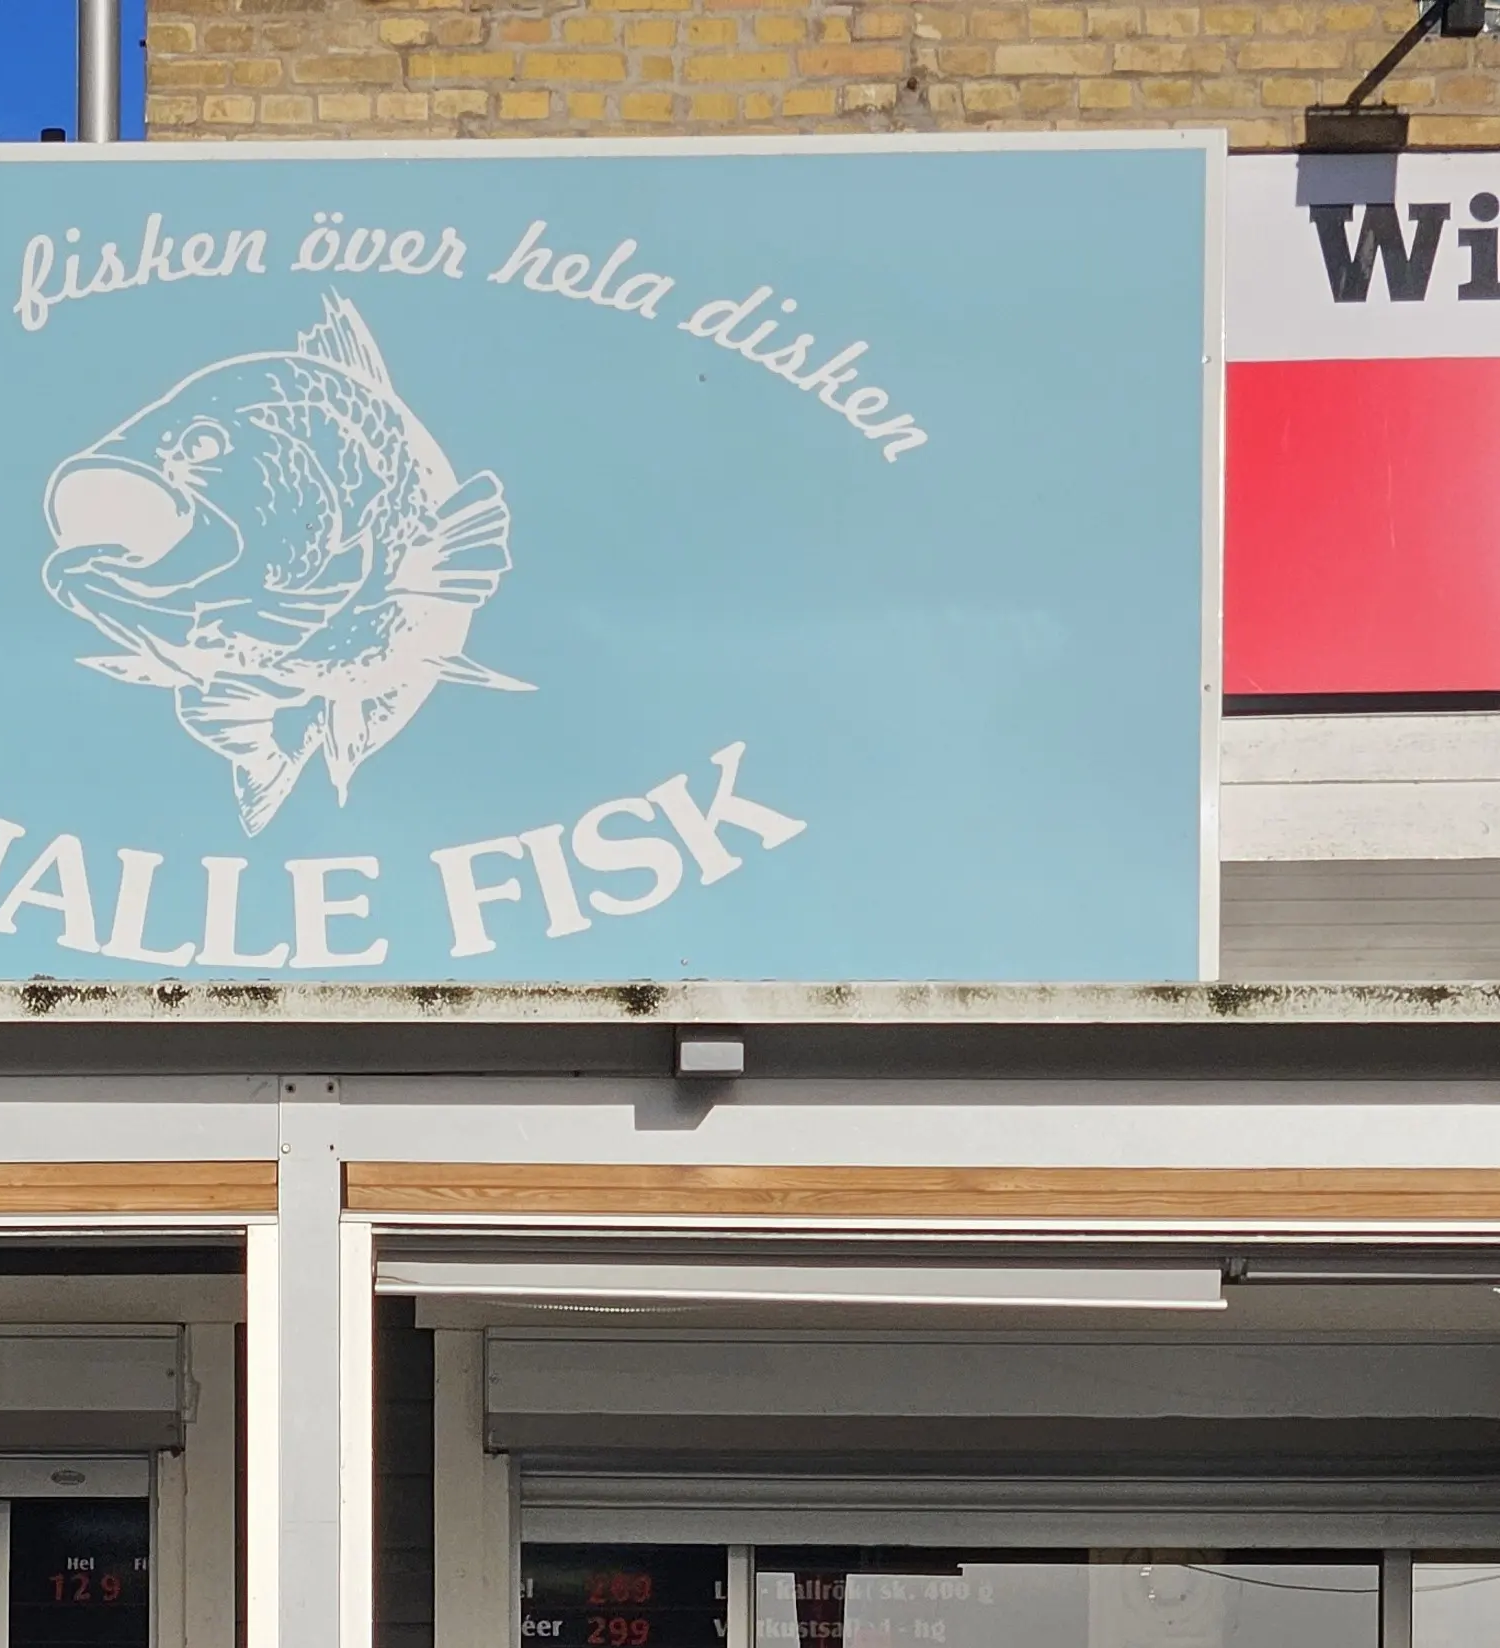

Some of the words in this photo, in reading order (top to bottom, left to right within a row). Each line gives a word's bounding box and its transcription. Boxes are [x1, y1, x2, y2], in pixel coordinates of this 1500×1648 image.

[13, 212, 267, 332] fisken
[290, 211, 467, 279] över
[486, 219, 675, 319] hela
[677, 285, 928, 464] disken
[429, 741, 807, 959] FISK
[67, 1556, 95, 1571] Hel
[50, 1573, 121, 1602] 129
[586, 1616, 650, 1646] 299
